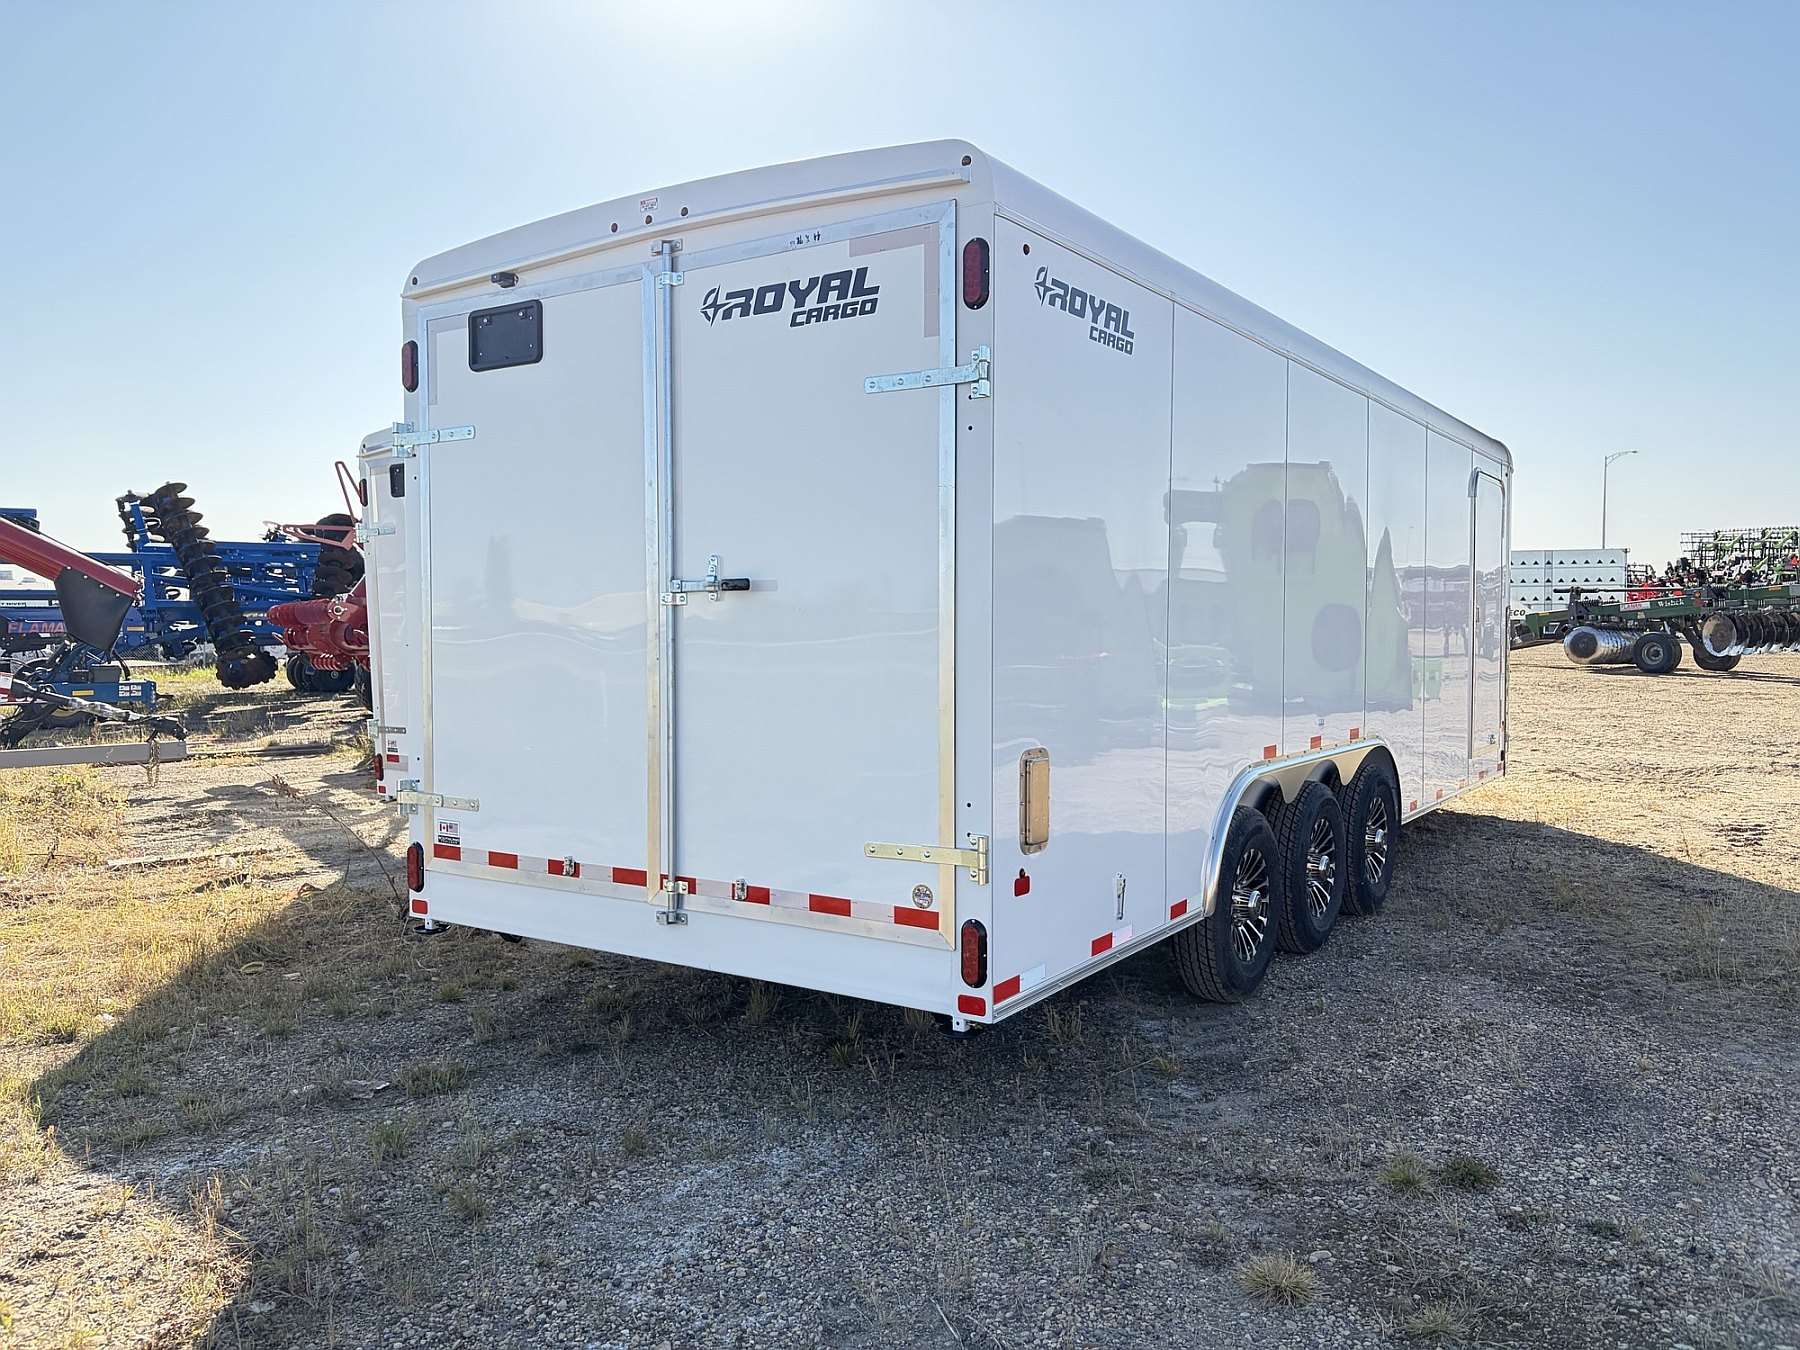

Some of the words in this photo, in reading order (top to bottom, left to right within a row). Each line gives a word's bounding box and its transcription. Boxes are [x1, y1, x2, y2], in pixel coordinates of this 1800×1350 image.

[721, 266, 881, 321] ROYAL
[789, 297, 879, 328] CARGO
[1048, 277, 1135, 340] ROYAL
[1088, 325, 1134, 356] CARGO
